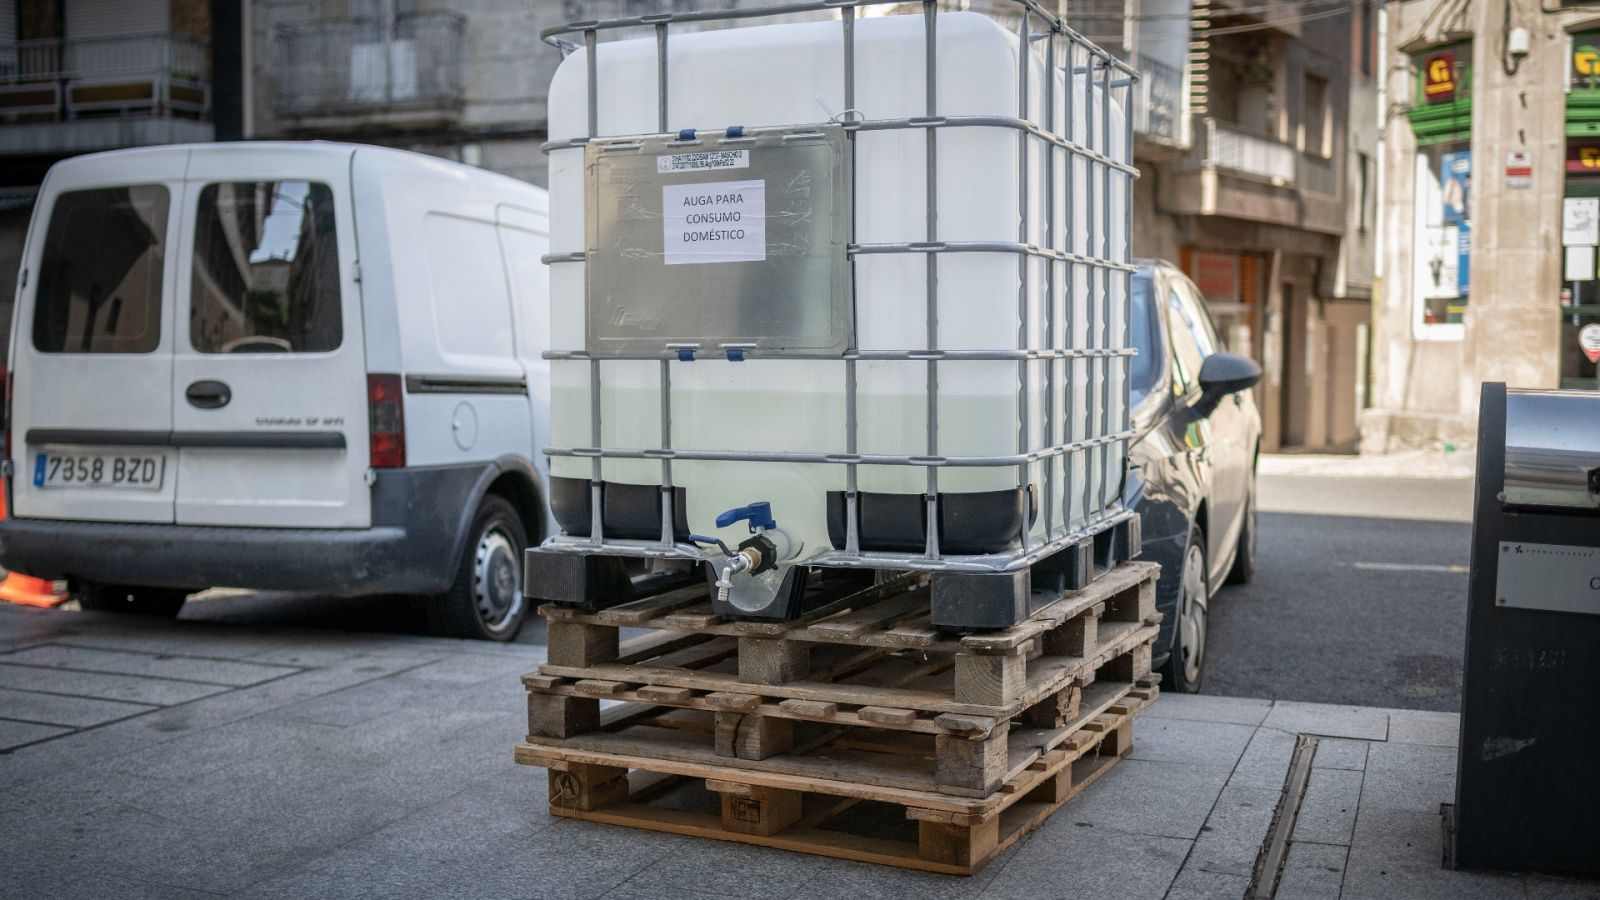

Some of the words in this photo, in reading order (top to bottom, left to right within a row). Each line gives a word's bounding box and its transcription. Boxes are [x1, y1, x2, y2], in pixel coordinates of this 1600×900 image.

[683, 195, 713, 207] AUGA
[716, 193, 744, 204] PARA
[686, 211, 741, 224] CONSUMO
[683, 228, 745, 242] DOMÉSTICO
[48, 457, 104, 482] 7358
[112, 457, 156, 483] BZD
